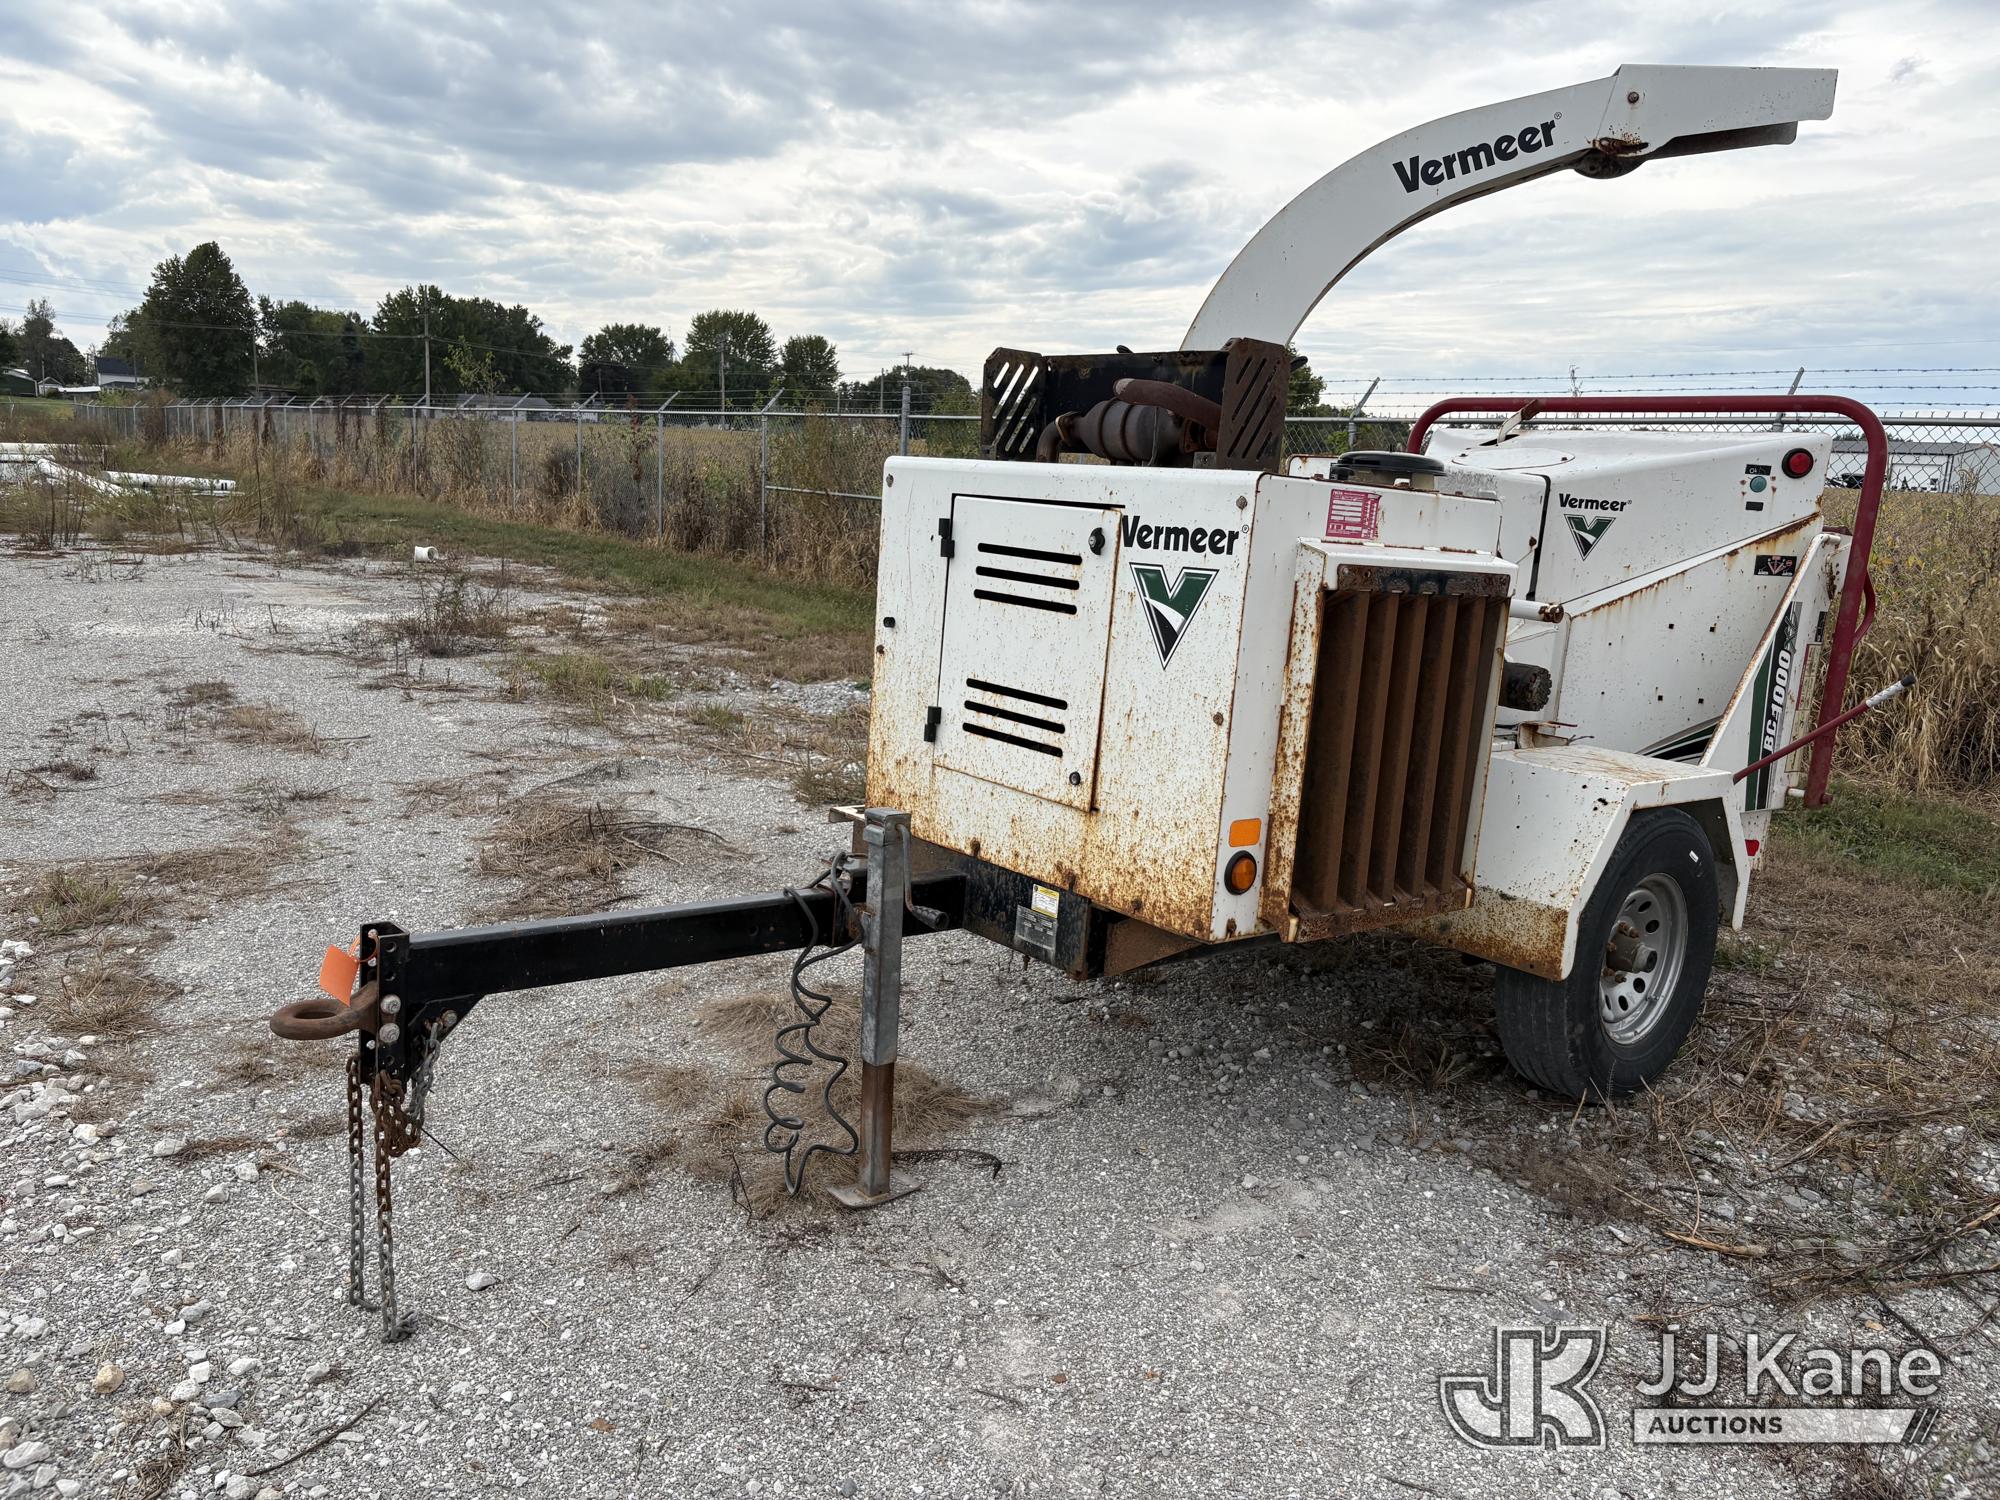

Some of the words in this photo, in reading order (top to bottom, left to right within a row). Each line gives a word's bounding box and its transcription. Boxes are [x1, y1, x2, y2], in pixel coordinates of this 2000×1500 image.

[1393, 119, 1557, 194] Vermeer
[1559, 493, 1627, 512] Vermeer
[1122, 515, 1240, 556] Vermeer
